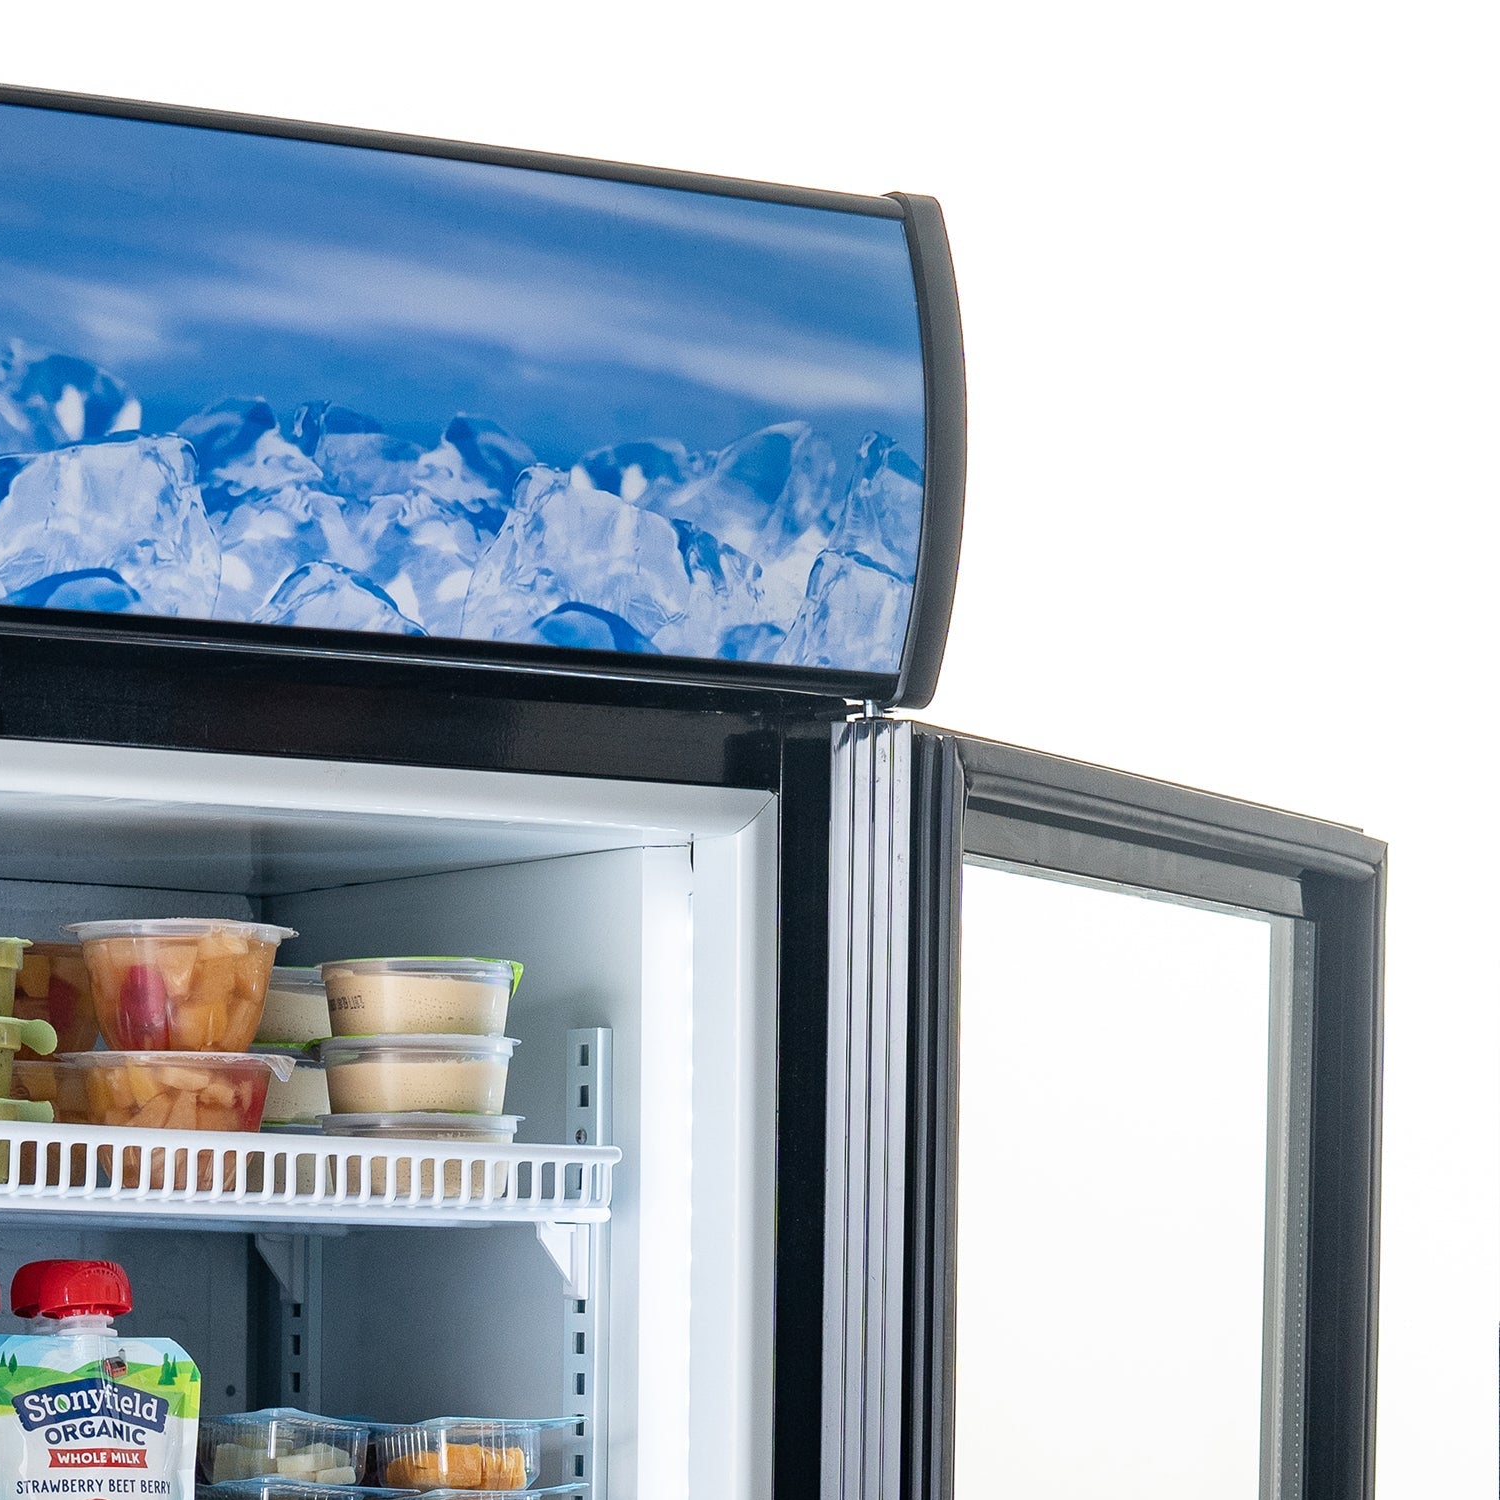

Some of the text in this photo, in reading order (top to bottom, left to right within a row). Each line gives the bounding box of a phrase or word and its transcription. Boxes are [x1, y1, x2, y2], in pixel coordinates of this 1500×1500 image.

[24, 1384, 158, 1422] Stonyfield
[44, 1420, 146, 1446] ORGANIC
[57, 1452, 140, 1464] WHOLE MILK
[16, 1479, 170, 1494] STRAWBERRY BEET BERRY
